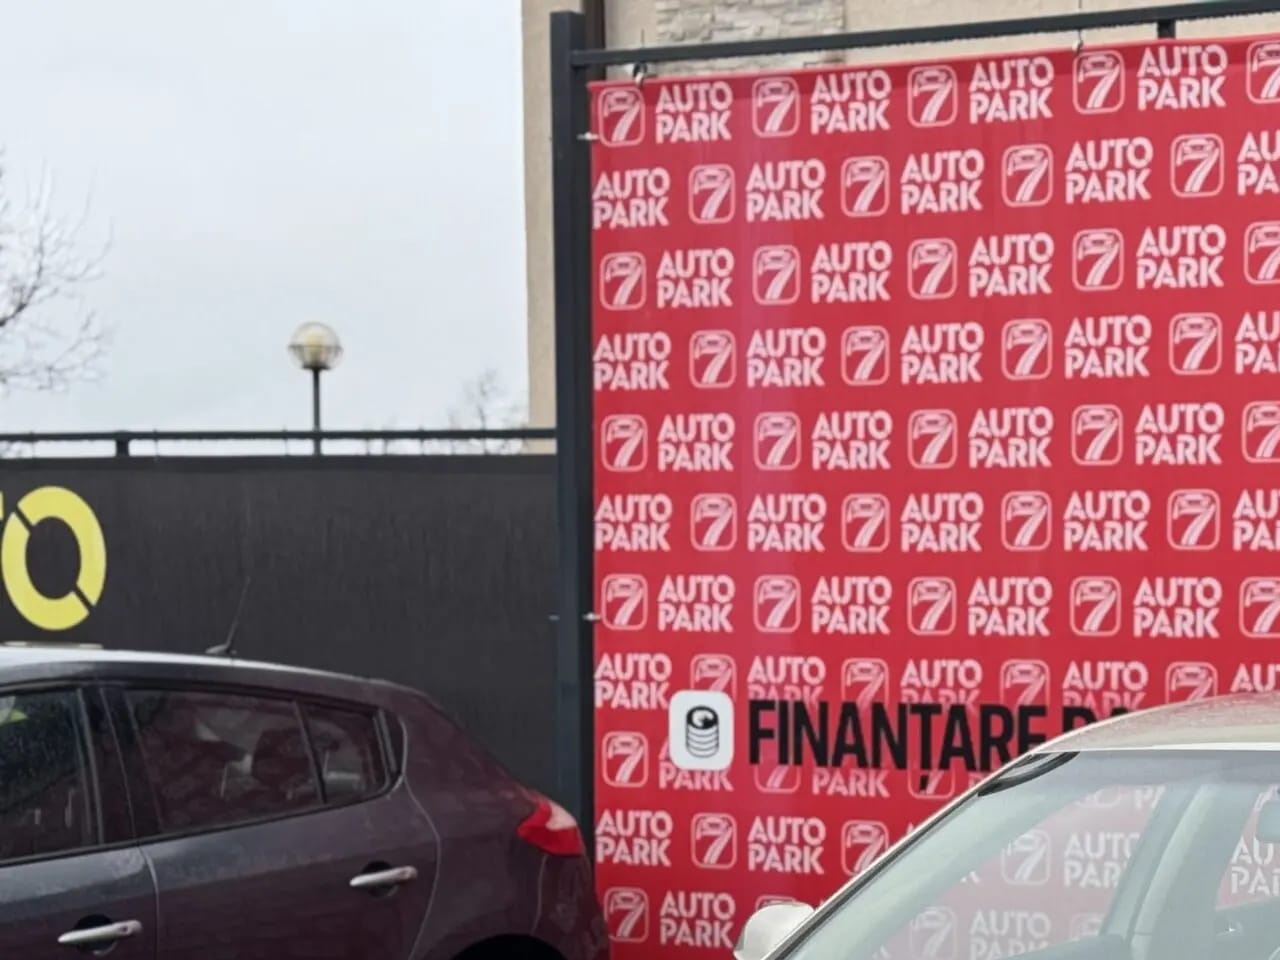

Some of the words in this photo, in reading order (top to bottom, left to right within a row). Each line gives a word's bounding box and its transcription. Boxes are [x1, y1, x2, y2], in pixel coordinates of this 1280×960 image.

[969, 57, 1053, 93] AUTO
[1137, 44, 1227, 77] AUTO
[656, 82, 732, 113] AUTO
[811, 70, 891, 104] AUTO
[1138, 76, 1225, 110] PARK
[811, 99, 889, 134] PARK
[970, 87, 1052, 123] PARK
[656, 110, 731, 143] PARK
[901, 149, 984, 183] AUTO
[1066, 137, 1153, 172] AUTO
[593, 168, 670, 200] AUTO
[746, 159, 825, 192] AUTO
[1066, 169, 1150, 203] PARK
[747, 189, 823, 221] PARK
[902, 179, 981, 214] PARK
[593, 196, 668, 229] PARK
[969, 233, 1054, 267] AUTO
[1137, 224, 1226, 257] AUTO
[657, 248, 734, 279] AUTO
[811, 241, 892, 273] AUTO
[1137, 256, 1223, 288] PARK
[658, 277, 732, 308] PARK
[812, 270, 890, 303] PARK
[970, 264, 1051, 297] PARK
[747, 327, 826, 358] AUTO
[901, 322, 984, 354] AUTO
[1065, 315, 1151, 348] AUTO
[593, 332, 671, 363] AUTO
[1065, 346, 1149, 378] PARK
[594, 360, 669, 390] PARK
[747, 356, 824, 387] PARK
[902, 352, 981, 384] PARK
[658, 413, 735, 443] AUTO
[812, 410, 892, 441] AUTO
[969, 407, 1053, 438] AUTO
[1136, 403, 1224, 434] AUTO
[658, 441, 733, 470] PARK
[813, 439, 890, 469] PARK
[970, 437, 1050, 468] PARK
[1136, 434, 1221, 464] PARK
[595, 494, 672, 522] AUTO
[748, 494, 826, 523] AUTO
[901, 493, 983, 523] AUTO
[1064, 490, 1150, 521] AUTO
[595, 522, 670, 550] PARK
[748, 523, 824, 551] PARK
[902, 522, 981, 552] PARK
[1064, 521, 1147, 550] PARK
[658, 575, 735, 603] AUTO
[812, 576, 892, 605] AUTO
[968, 577, 1052, 606] AUTO
[1134, 577, 1222, 607] AUTO
[659, 602, 732, 632] PARK
[812, 605, 889, 634] PARK
[969, 606, 1049, 635] PARK
[1134, 606, 1218, 637] PARK
[594, 653, 671, 681] AUTO
[747, 656, 826, 686] AUTO
[901, 660, 983, 690] AUTO
[1063, 661, 1150, 691] AUTO
[595, 680, 668, 709] PARK
[659, 764, 734, 792] PARK
[813, 769, 890, 798] PARK
[596, 810, 672, 839] AUTO
[748, 816, 825, 845] AUTO
[597, 835, 670, 866] PARK
[749, 842, 824, 874] PARK
[660, 892, 735, 920] AUTO
[661, 918, 733, 948] PARK
